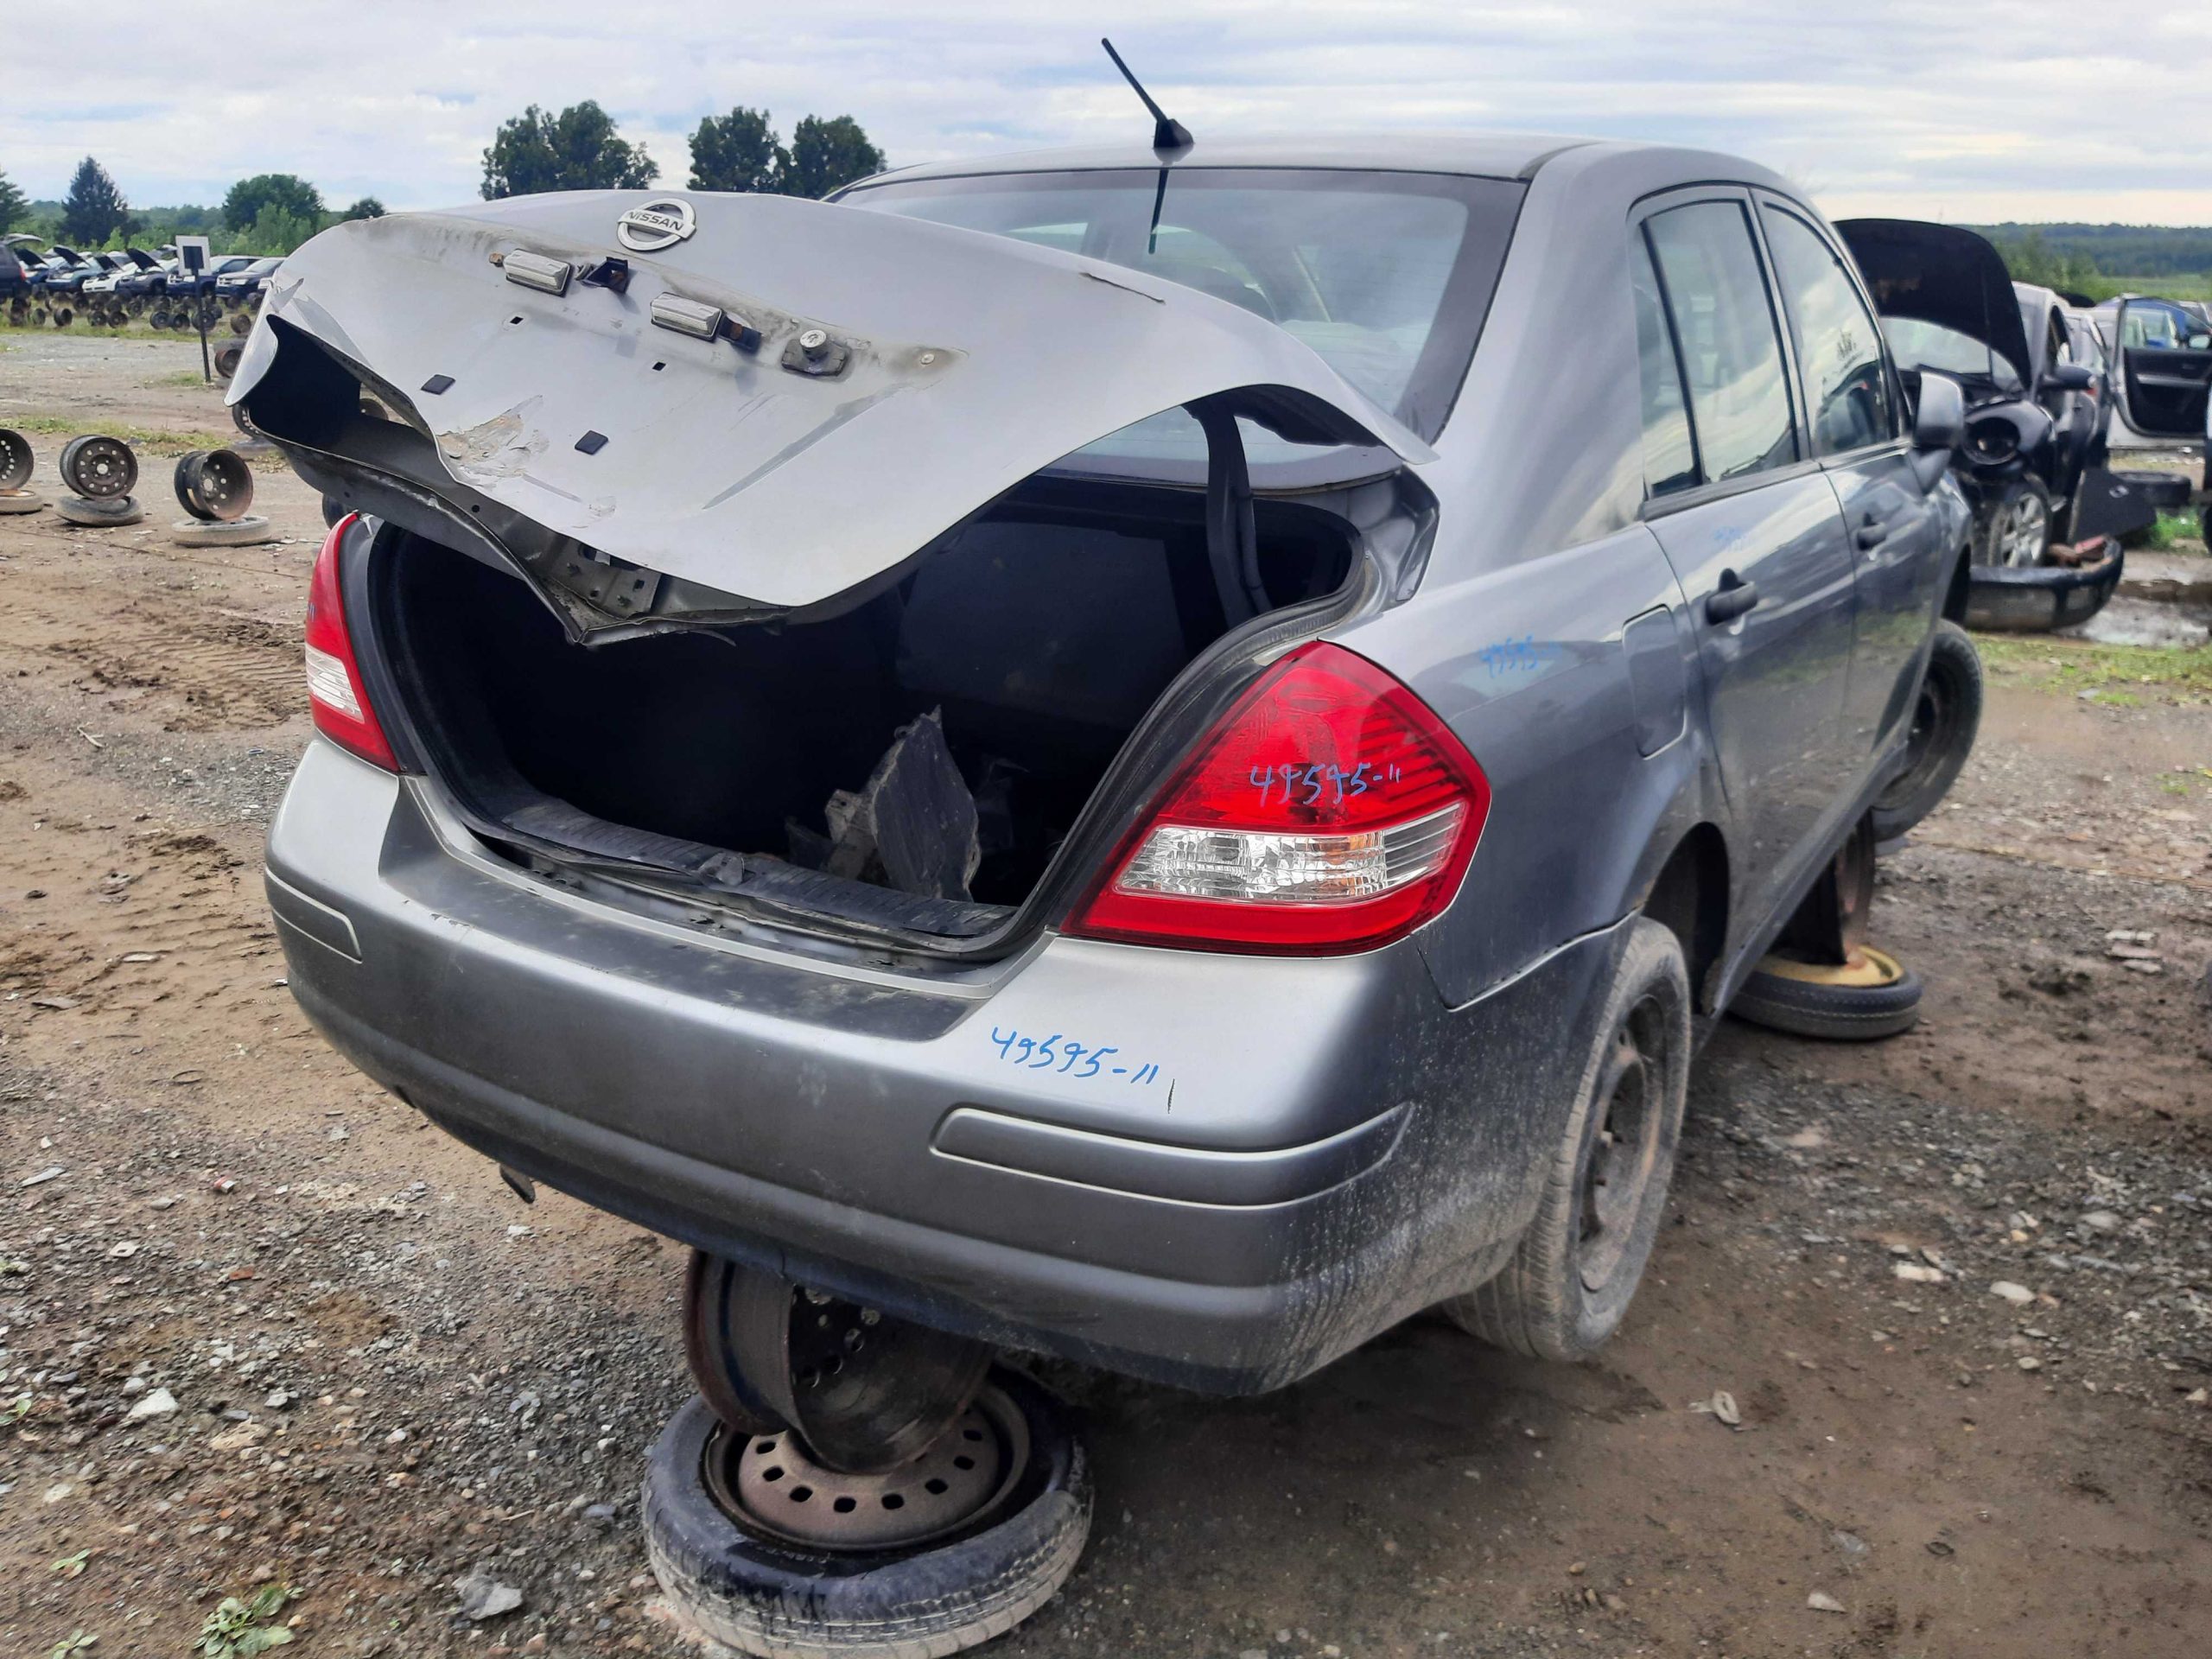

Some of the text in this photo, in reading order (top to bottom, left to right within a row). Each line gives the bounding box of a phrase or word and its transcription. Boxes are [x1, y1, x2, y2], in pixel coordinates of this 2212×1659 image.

[628, 211, 684, 232] NISSAN
[1249, 762, 1402, 808] 49595-11
[991, 1027, 1160, 1085] 49595-11
